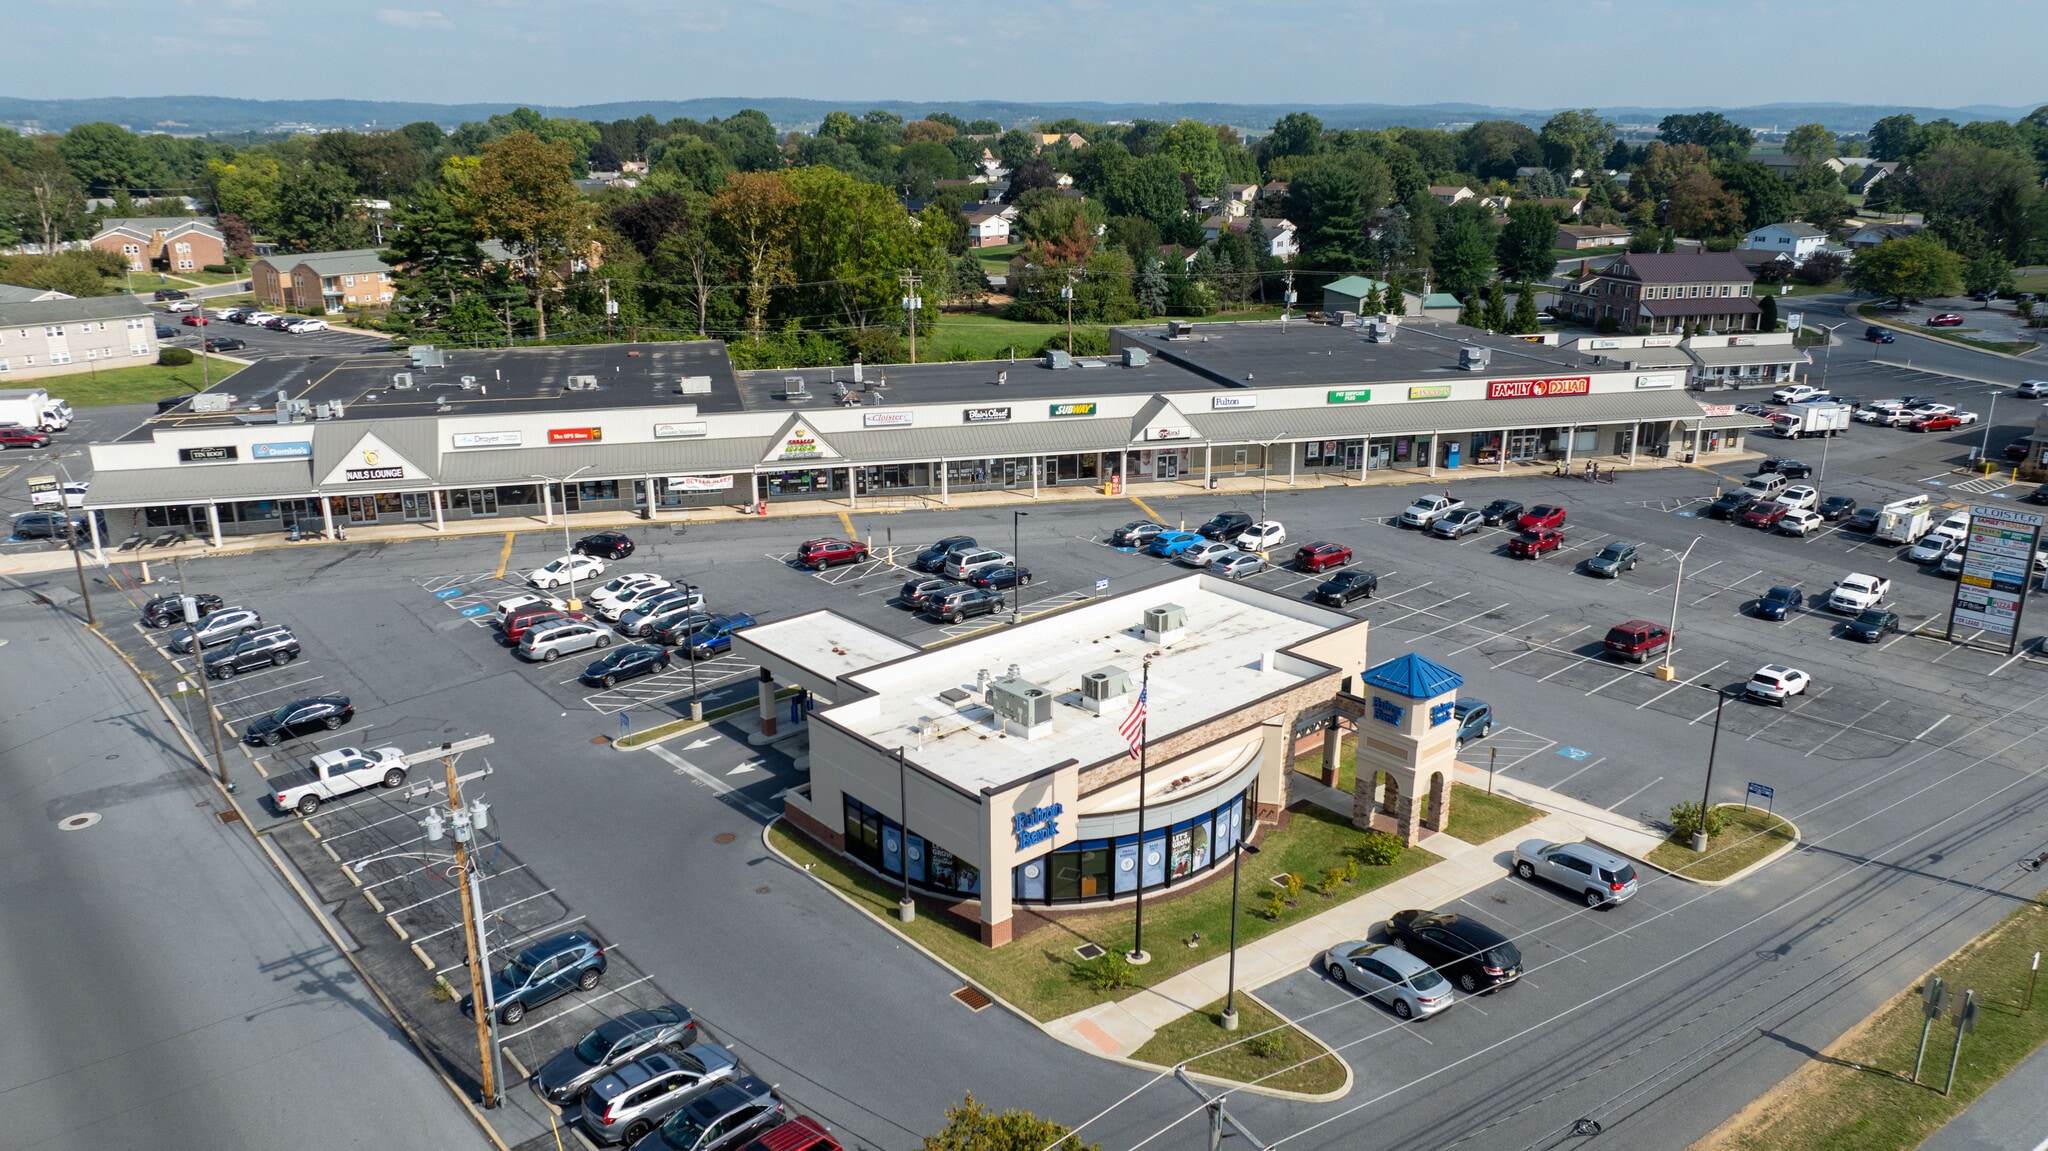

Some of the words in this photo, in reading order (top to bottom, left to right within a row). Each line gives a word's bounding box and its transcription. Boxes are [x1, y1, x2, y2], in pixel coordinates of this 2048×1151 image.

[1492, 382, 1532, 397] FAMILY
[1548, 379, 1587, 394] DOLLAR
[1215, 397, 1239, 406] Fulton
[1055, 403, 1094, 415] SUBWAY
[268, 445, 308, 457] Domino's
[347, 470, 370, 480] NAILS
[370, 468, 403, 479] LOUNGE
[1974, 507, 2038, 523] CLOISTER
[1992, 600, 2012, 609] PIZZA
[1013, 802, 1063, 834] Fulton
[1017, 819, 1060, 851] Bank
[1172, 832, 1188, 842] LET'S
[1172, 836, 1191, 849] GROW
